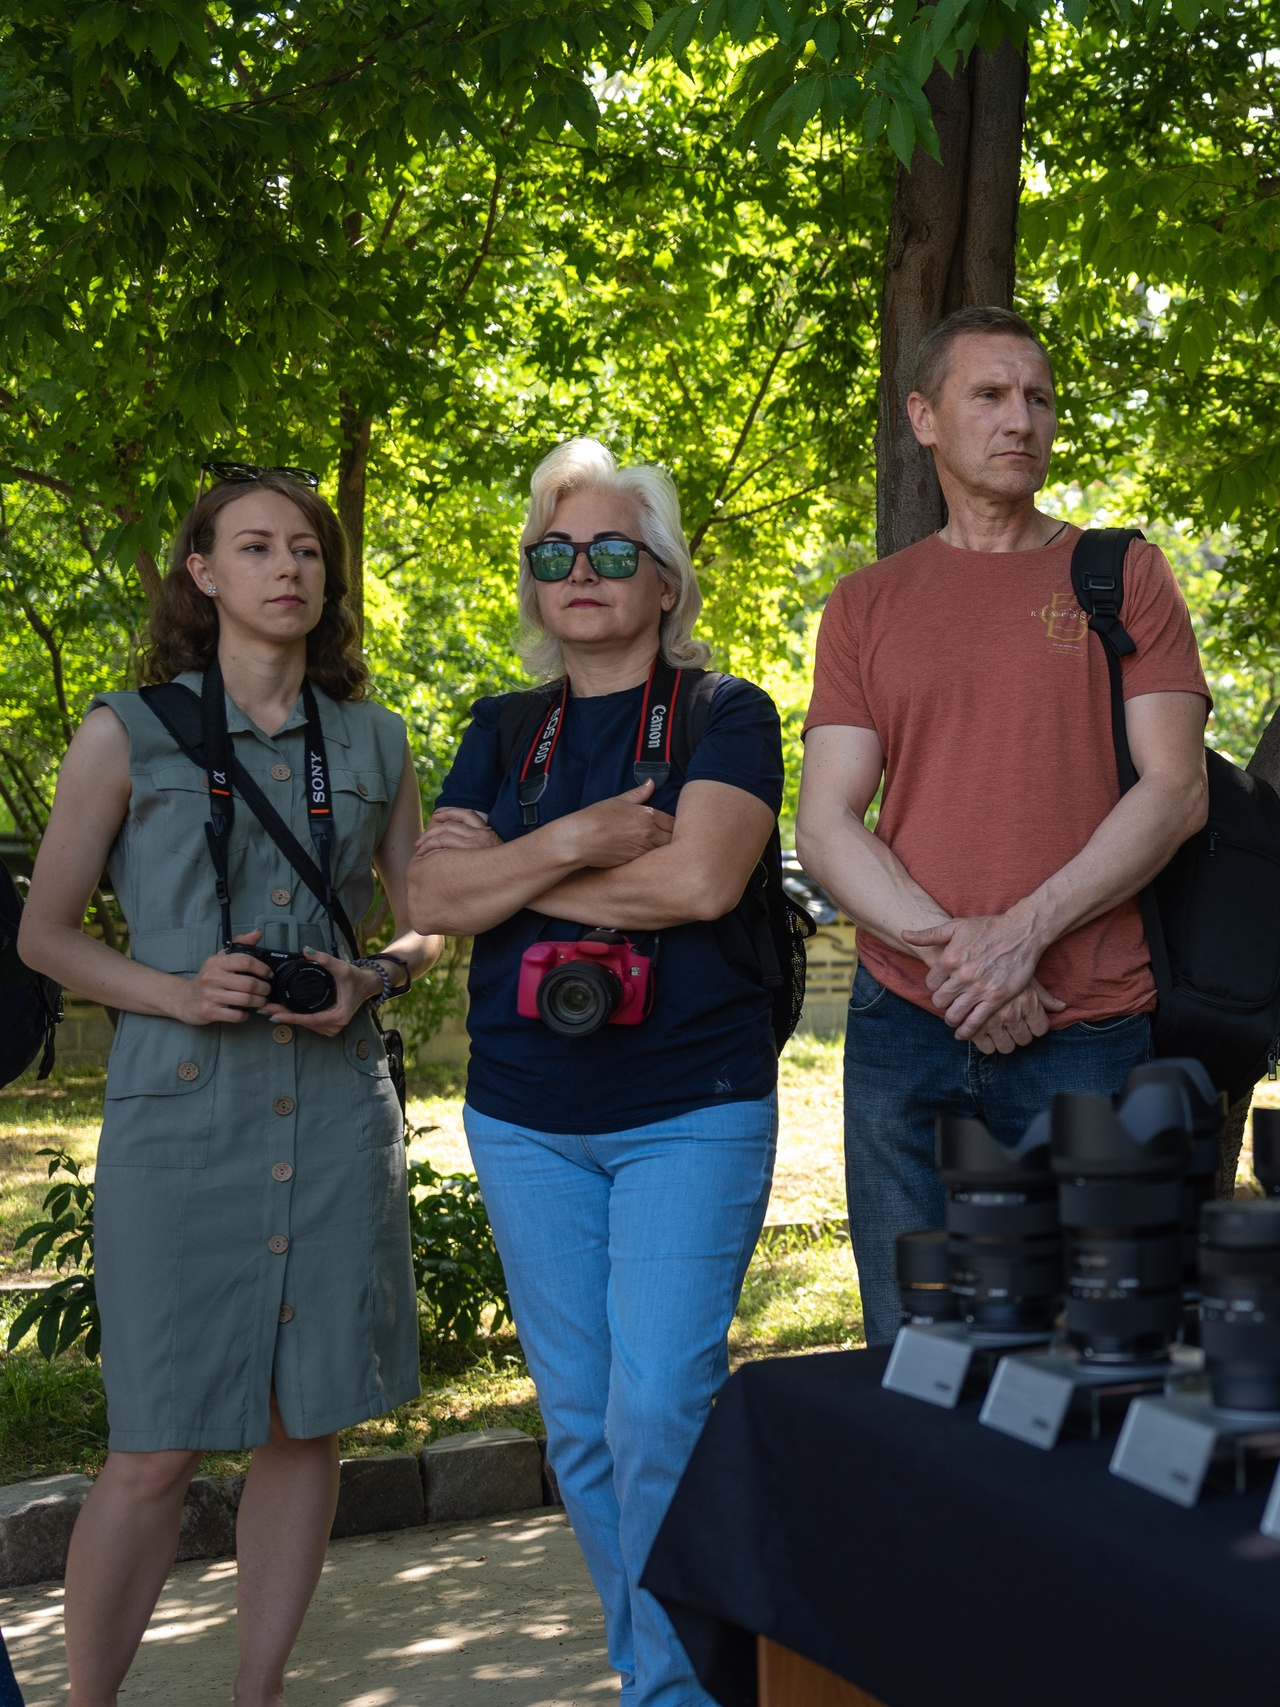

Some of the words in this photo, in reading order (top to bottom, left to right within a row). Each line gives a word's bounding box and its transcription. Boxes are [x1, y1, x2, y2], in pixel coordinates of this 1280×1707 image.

[542, 707, 561, 741] EOS
[646, 704, 668, 750] Canon
[533, 739, 552, 765] 60D
[310, 750, 327, 804] SONY
[270, 951, 290, 960] SONY
